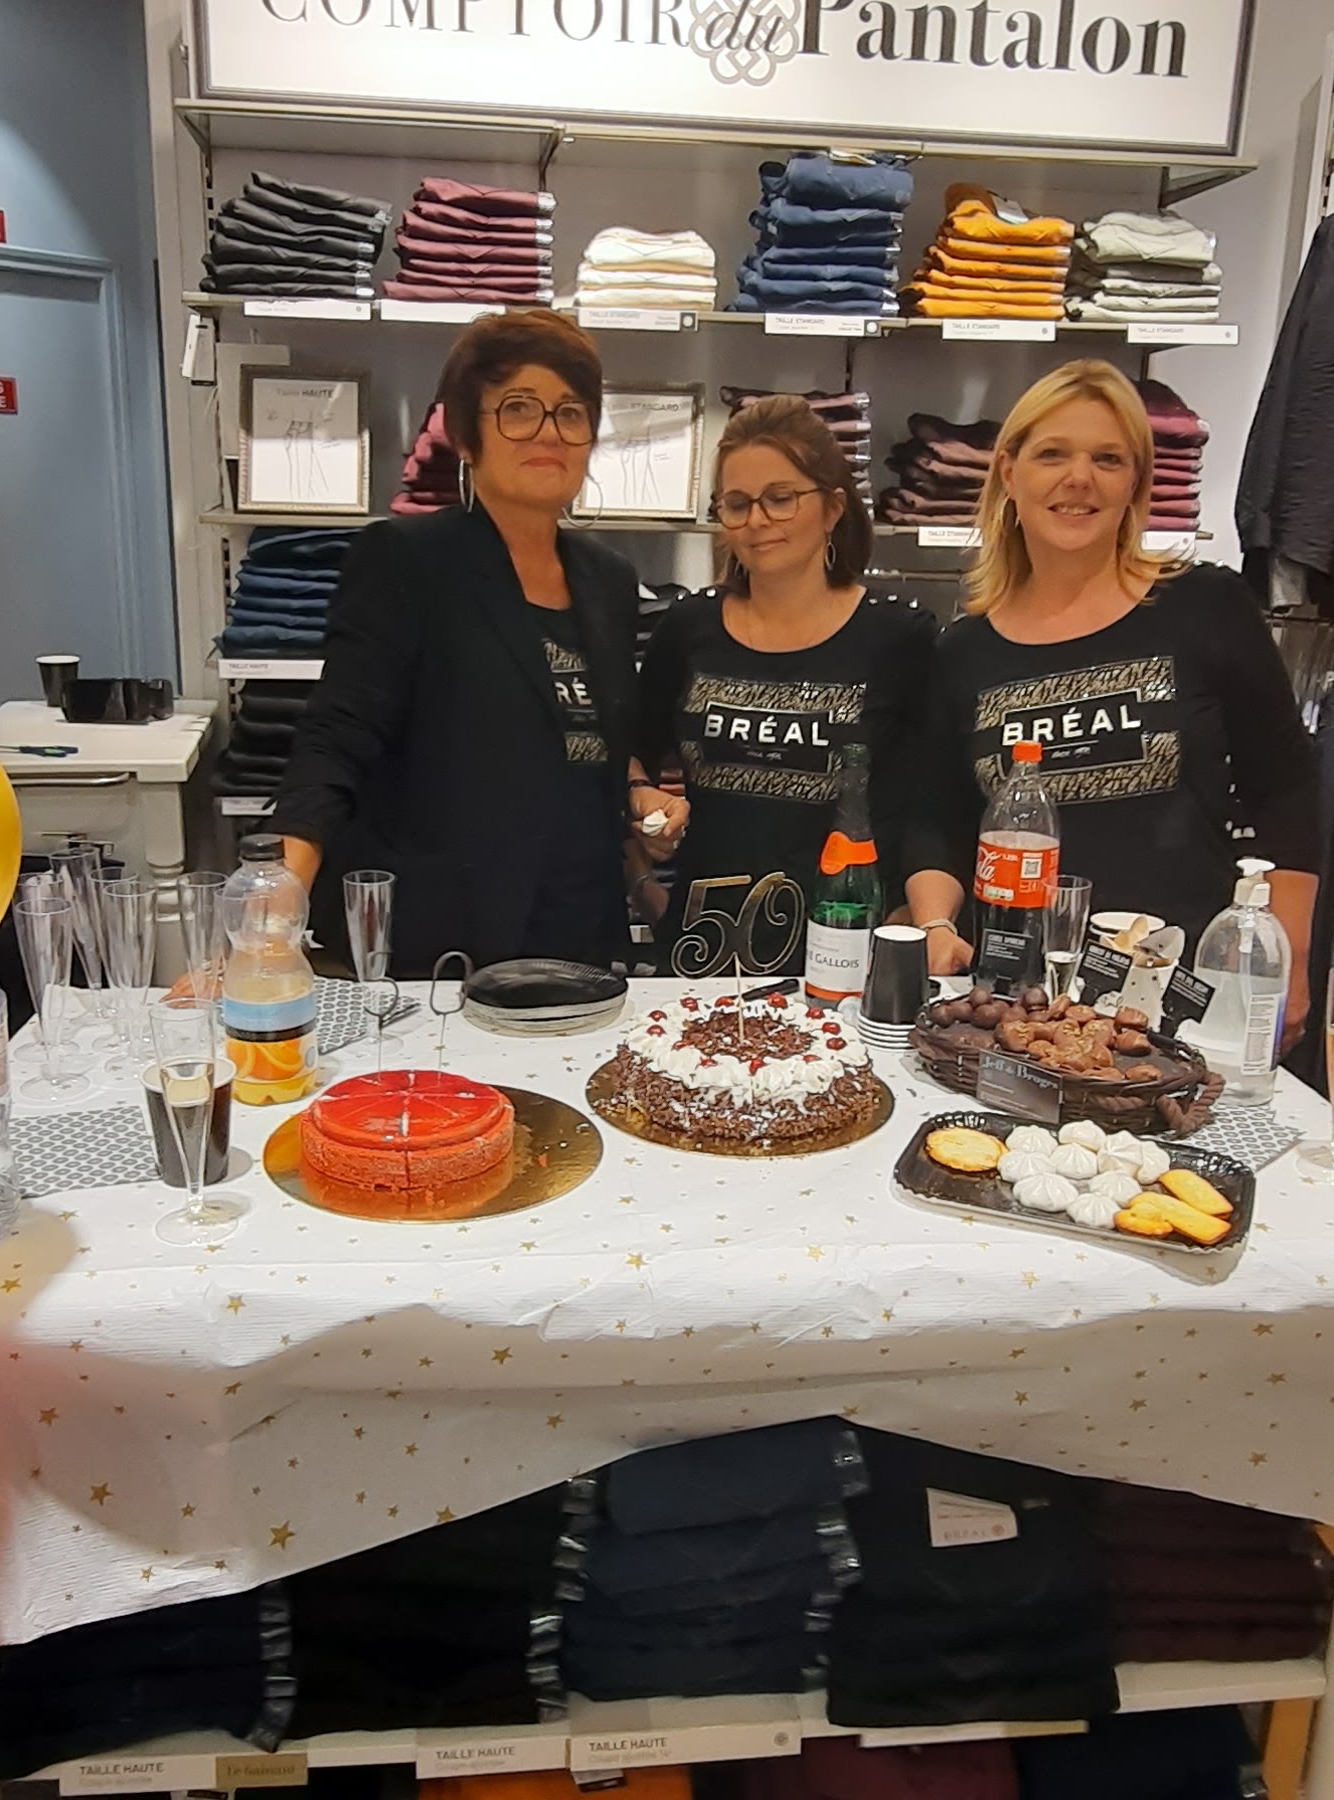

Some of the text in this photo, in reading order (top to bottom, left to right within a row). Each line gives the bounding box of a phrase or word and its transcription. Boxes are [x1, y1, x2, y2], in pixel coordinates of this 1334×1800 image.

[703, 0, 784, 54] du
[797, 0, 1189, 78] Pantalon
[704, 714, 830, 747] BRÉAL
[1002, 704, 1142, 746] BRÉAL
[671, 871, 805, 980] 50
[815, 953, 860, 968] GALLOIS
[982, 1056, 1006, 1071] Jeff
[589, 1737, 668, 1752] TAILLE HAUTE
[435, 1746, 516, 1760] TAILLE HAUTE
[80, 1764, 121, 1776] TAILLE
[123, 1762, 164, 1774] HAUTE
